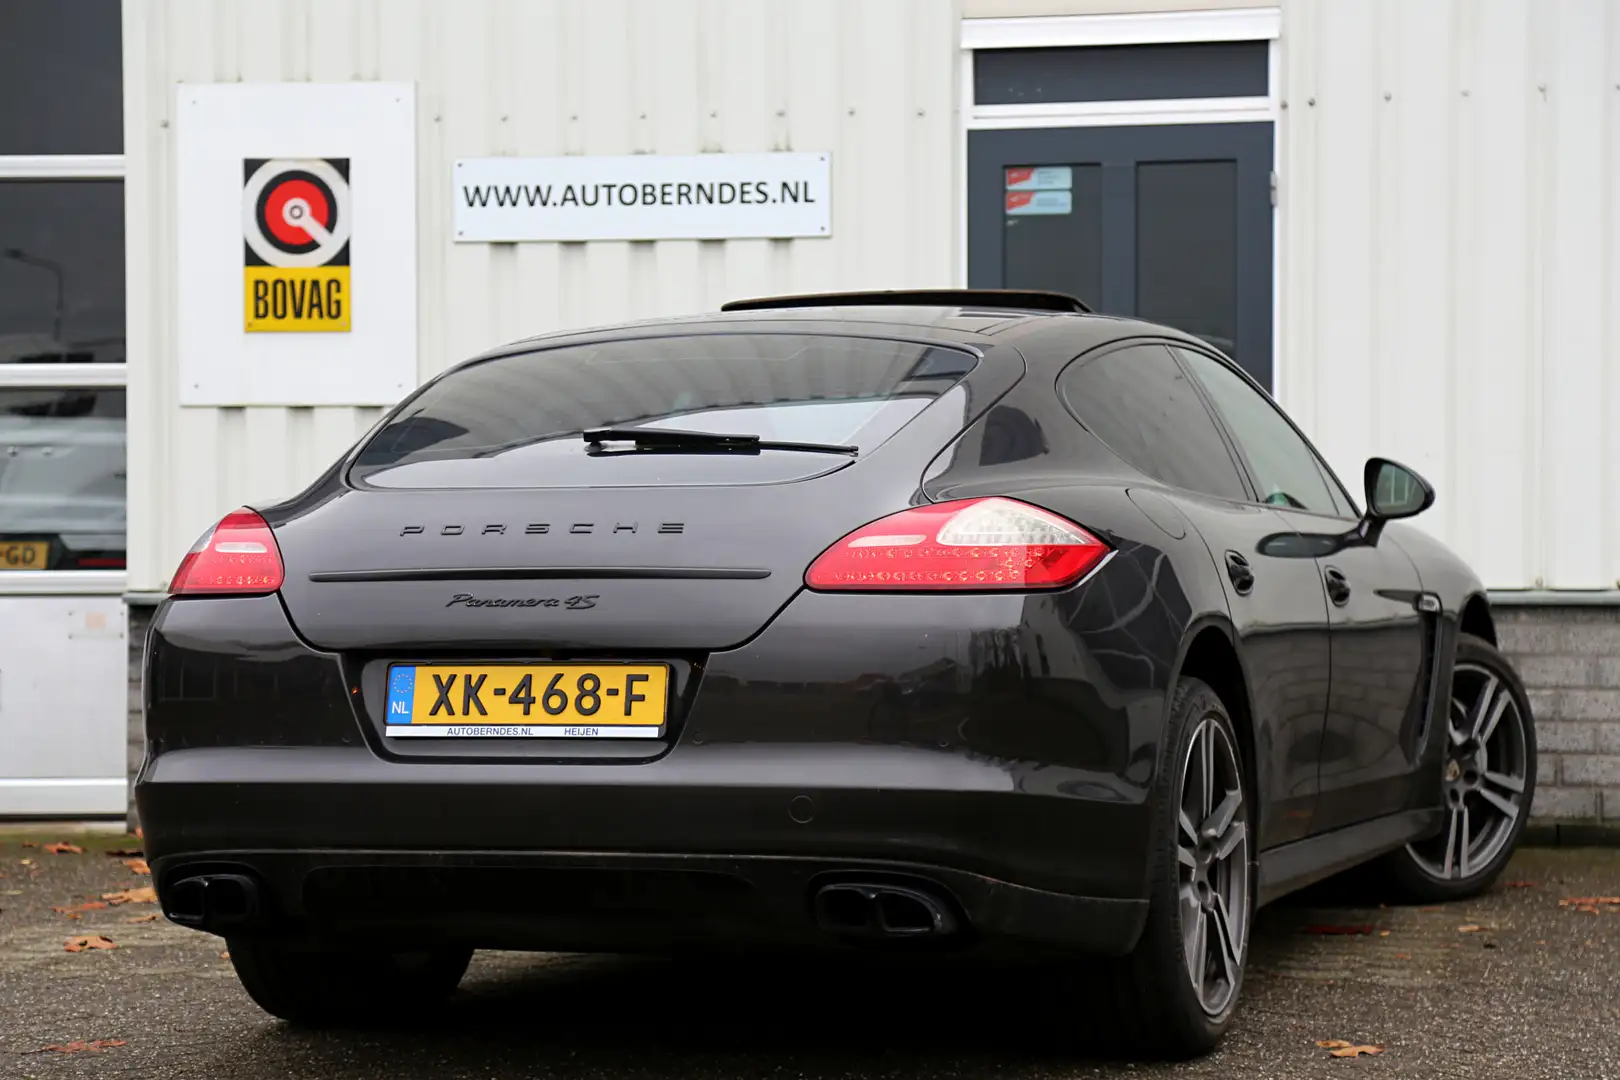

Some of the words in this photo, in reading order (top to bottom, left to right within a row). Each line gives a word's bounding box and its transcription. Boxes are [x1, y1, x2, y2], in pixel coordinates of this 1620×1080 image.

[464, 181, 815, 207] WWW.AUTOBERNDES.NL
[253, 278, 342, 320] BOVAG
[400, 523, 685, 536] PORSCHE
[446, 593, 559, 608] Panamera
[564, 595, 600, 610] 4S
[429, 672, 650, 717] XK-468-F
[391, 701, 410, 715] NL
[447, 727, 534, 736] AUTOBERNDES.NL
[564, 727, 599, 736] HEIJEN
